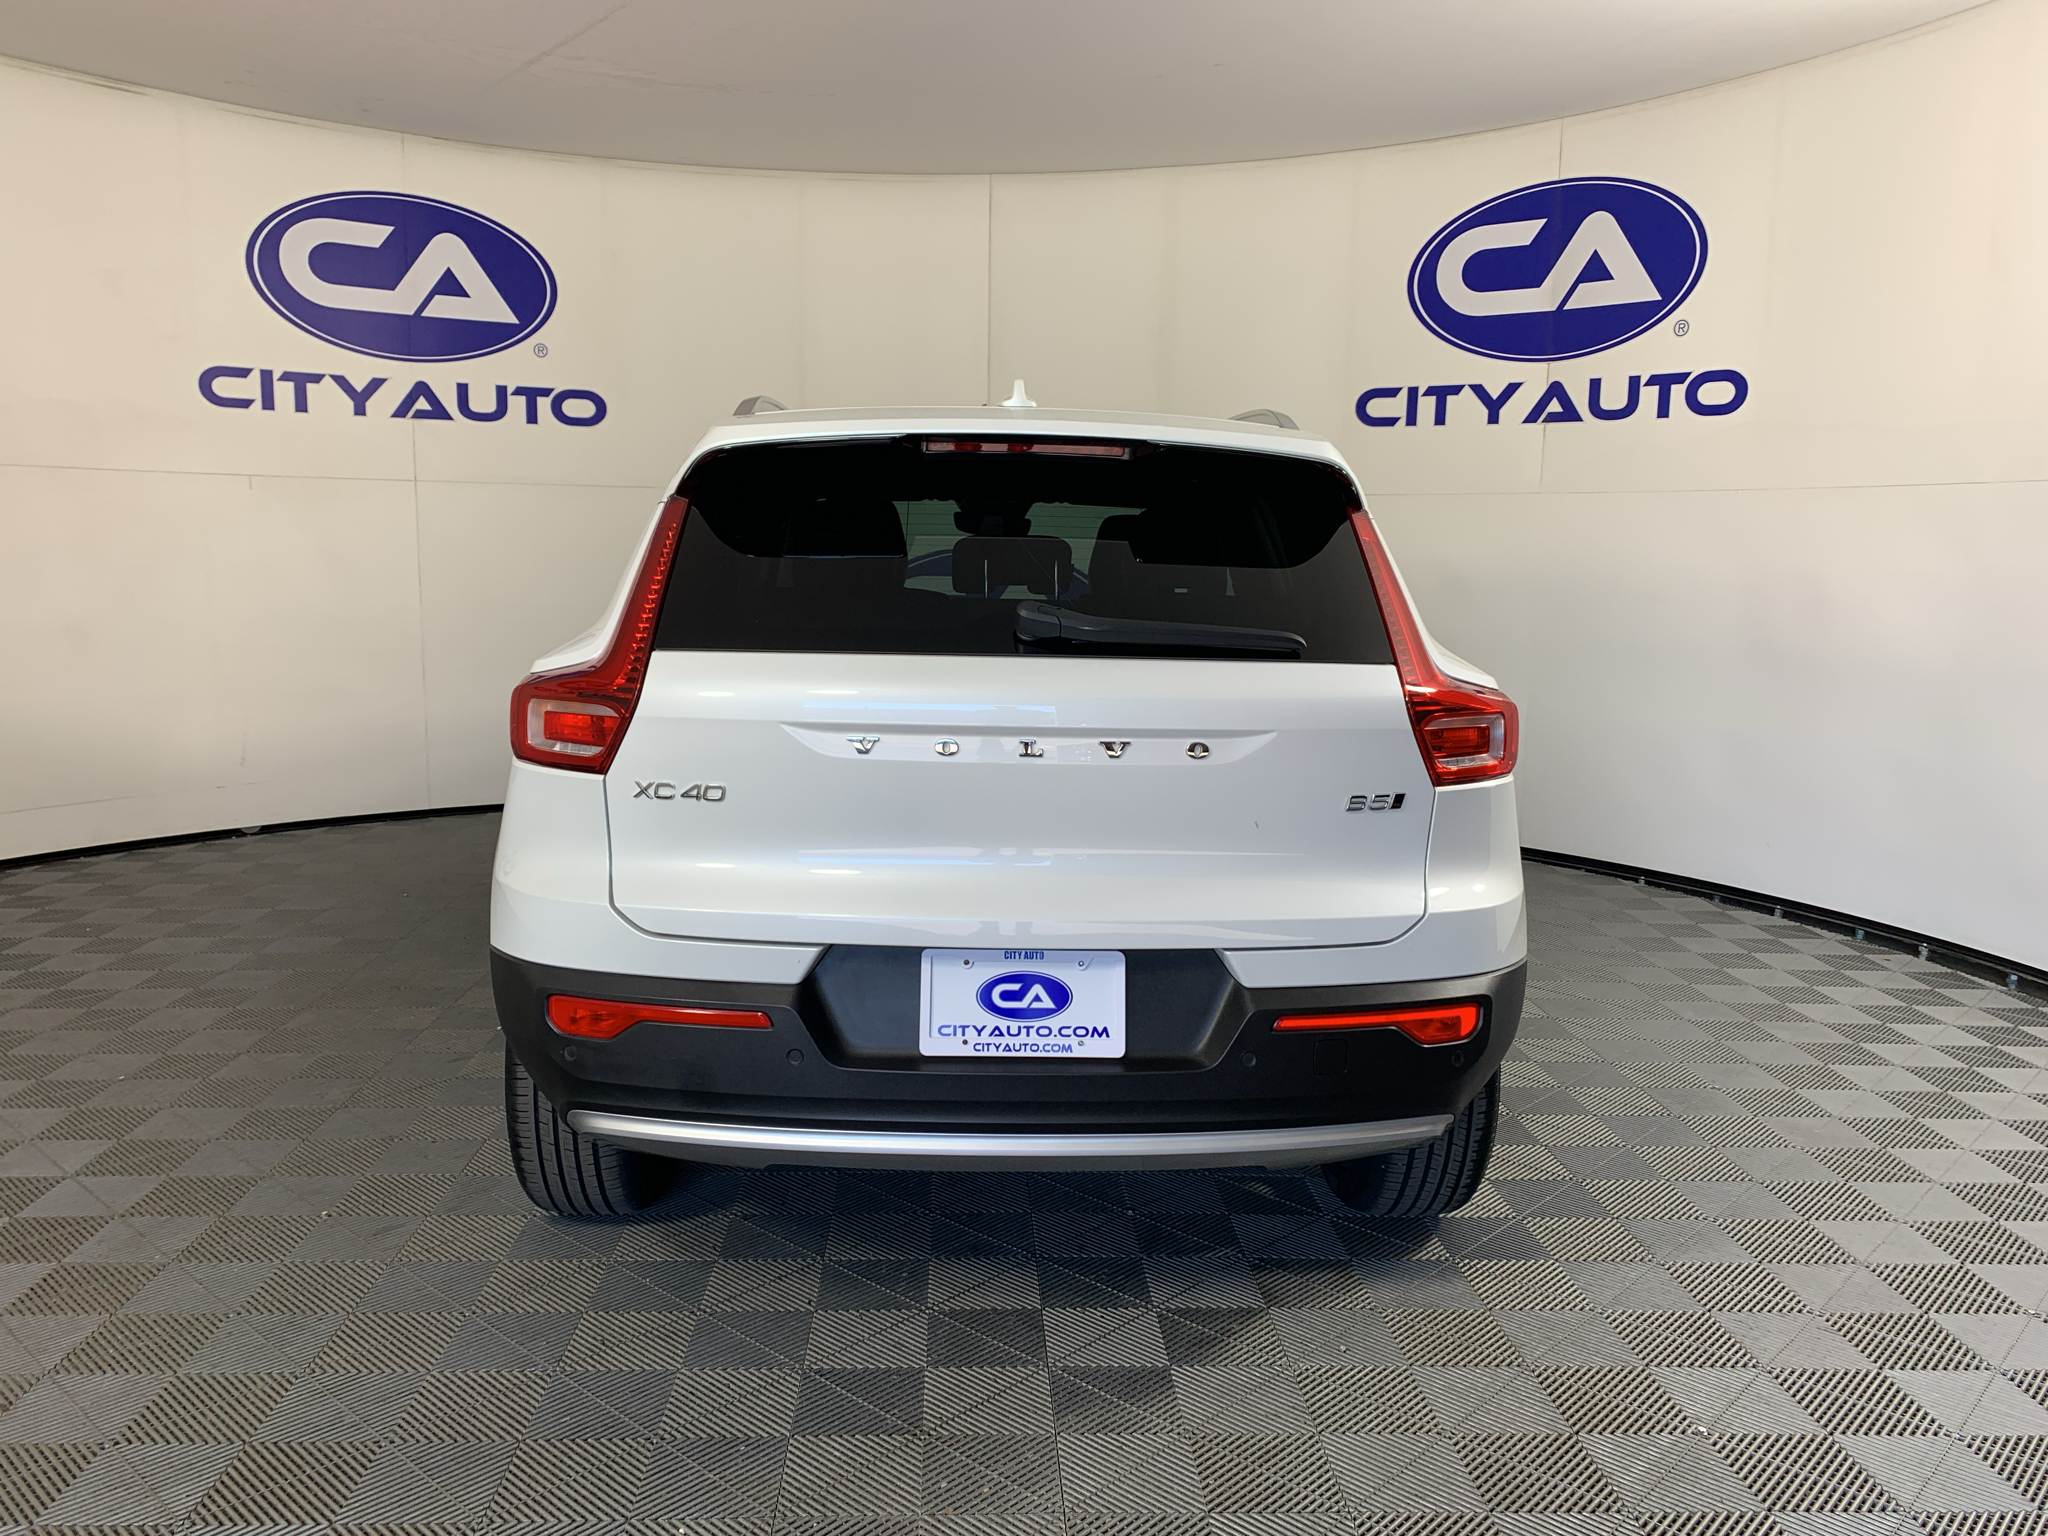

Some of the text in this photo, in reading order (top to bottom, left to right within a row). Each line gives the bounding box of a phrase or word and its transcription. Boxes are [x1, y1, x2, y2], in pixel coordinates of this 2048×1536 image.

[279, 217, 520, 325] CA
[1436, 210, 1662, 317] CA
[846, 735, 1210, 761] VOLVO
[1004, 950, 1045, 961] CITY AUTO
[991, 983, 1058, 1010] CA
[937, 1024, 1111, 1039] CITYAUTO.COM
[973, 1042, 1074, 1054] CITYAUTO.COM
